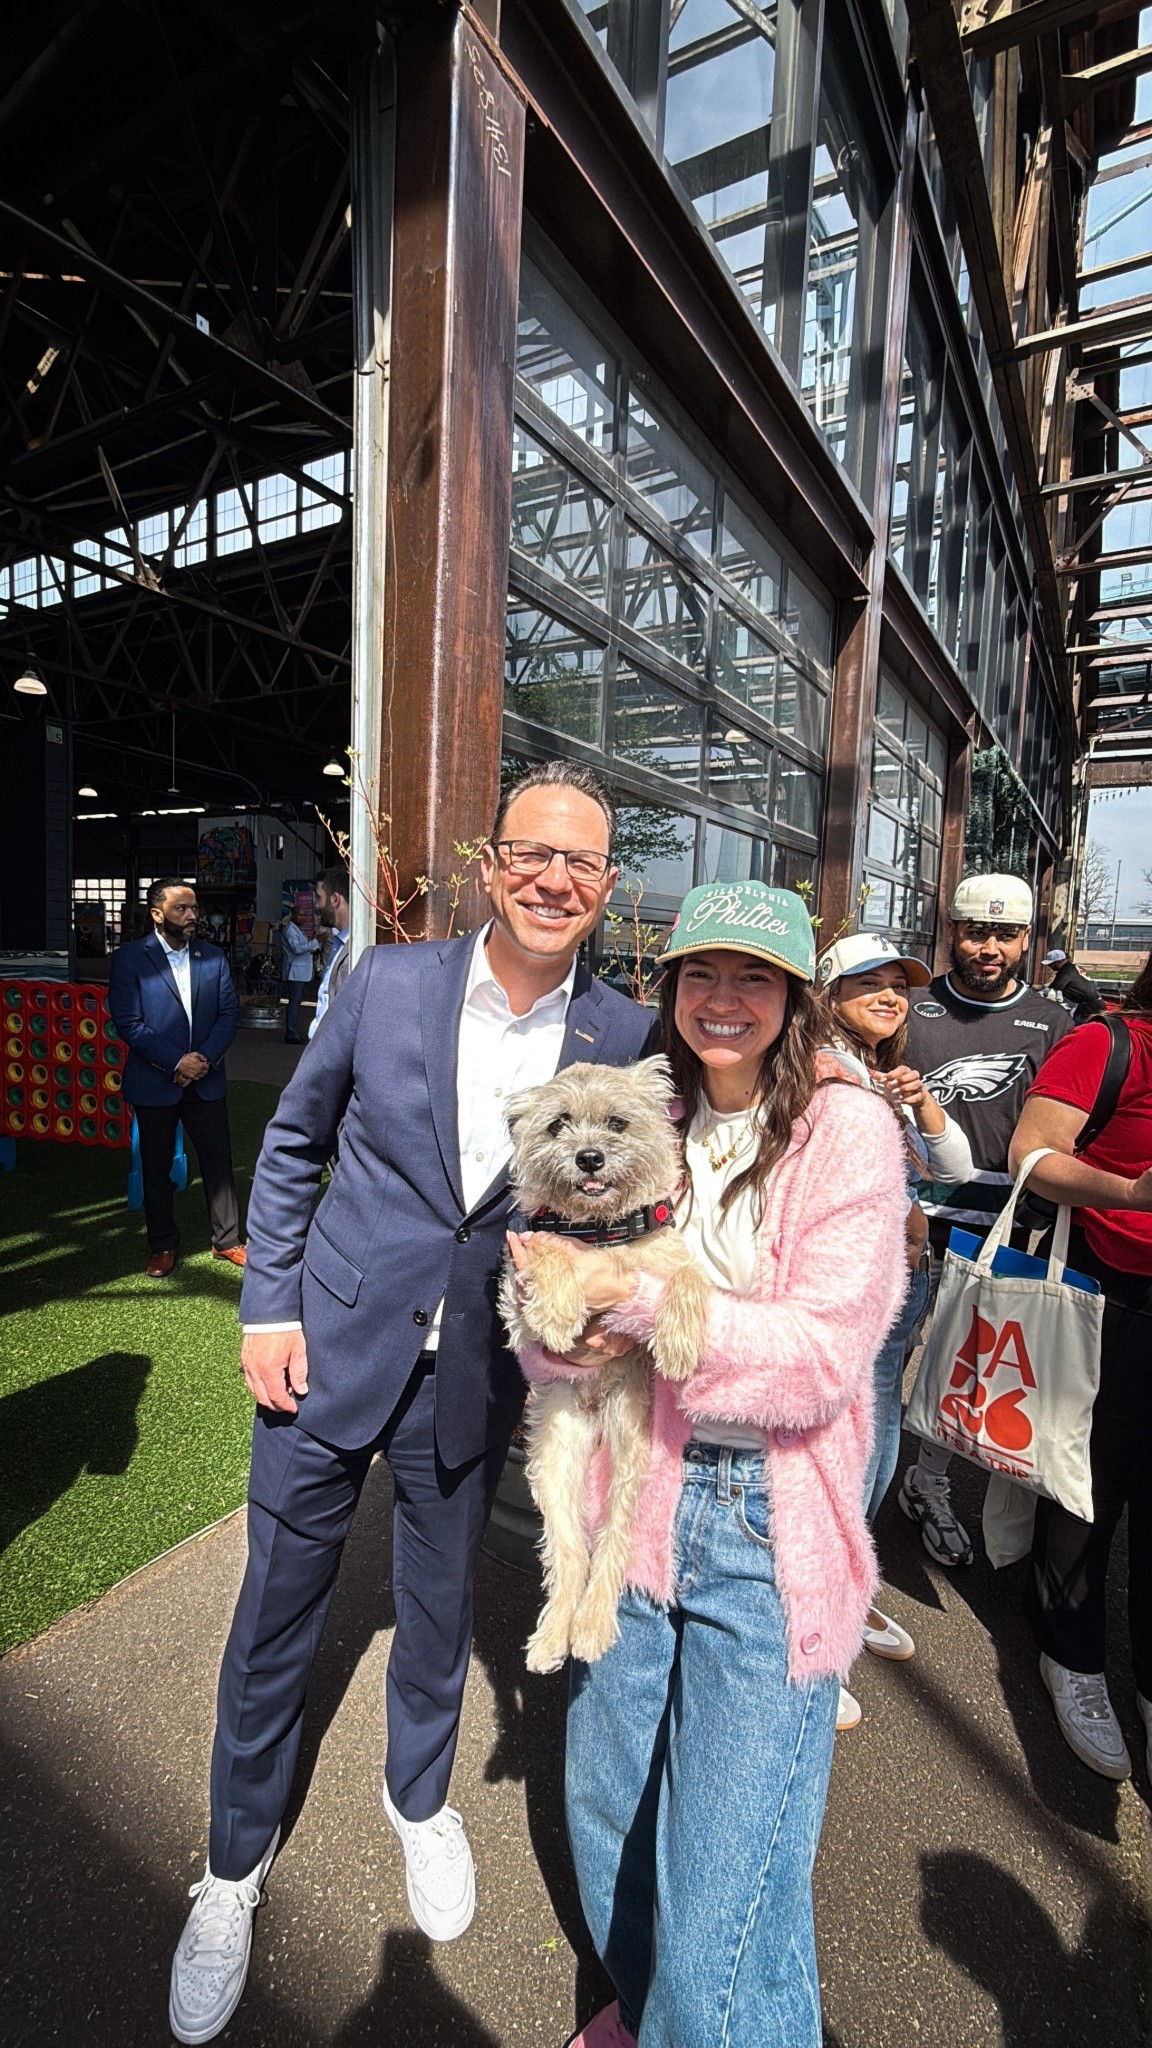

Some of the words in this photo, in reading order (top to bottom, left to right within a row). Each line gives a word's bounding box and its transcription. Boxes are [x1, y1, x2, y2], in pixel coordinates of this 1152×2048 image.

[686, 893, 790, 936] Phillies
[700, 885, 789, 907] PHILADELPHIA
[1013, 1019, 1049, 1032] EAGLES
[956, 1303, 1037, 1389] PA
[940, 1361, 1033, 1451] 26
[936, 1426, 965, 1452] IT'S
[969, 1450, 982, 1462] A
[985, 1455, 1029, 1479] TRIP
